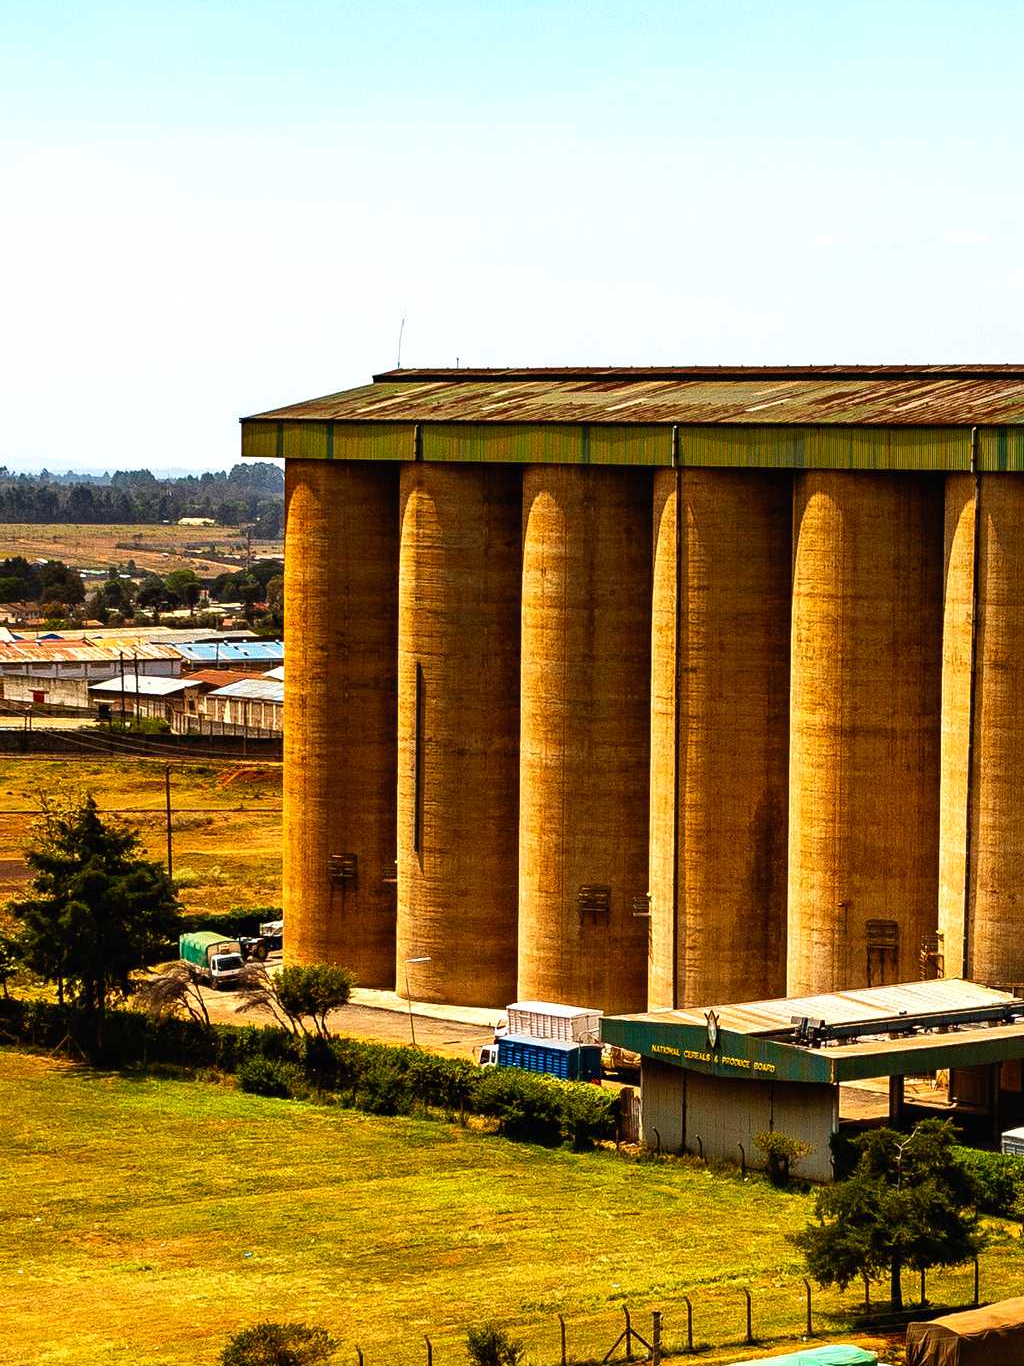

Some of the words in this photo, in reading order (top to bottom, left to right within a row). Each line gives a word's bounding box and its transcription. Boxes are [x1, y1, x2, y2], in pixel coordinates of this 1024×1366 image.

[651, 1044, 680, 1056] NATIONAL
[683, 1050, 711, 1062] CEREALS
[721, 1056, 750, 1068] PRODUCE
[753, 1061, 776, 1073] BOARD
